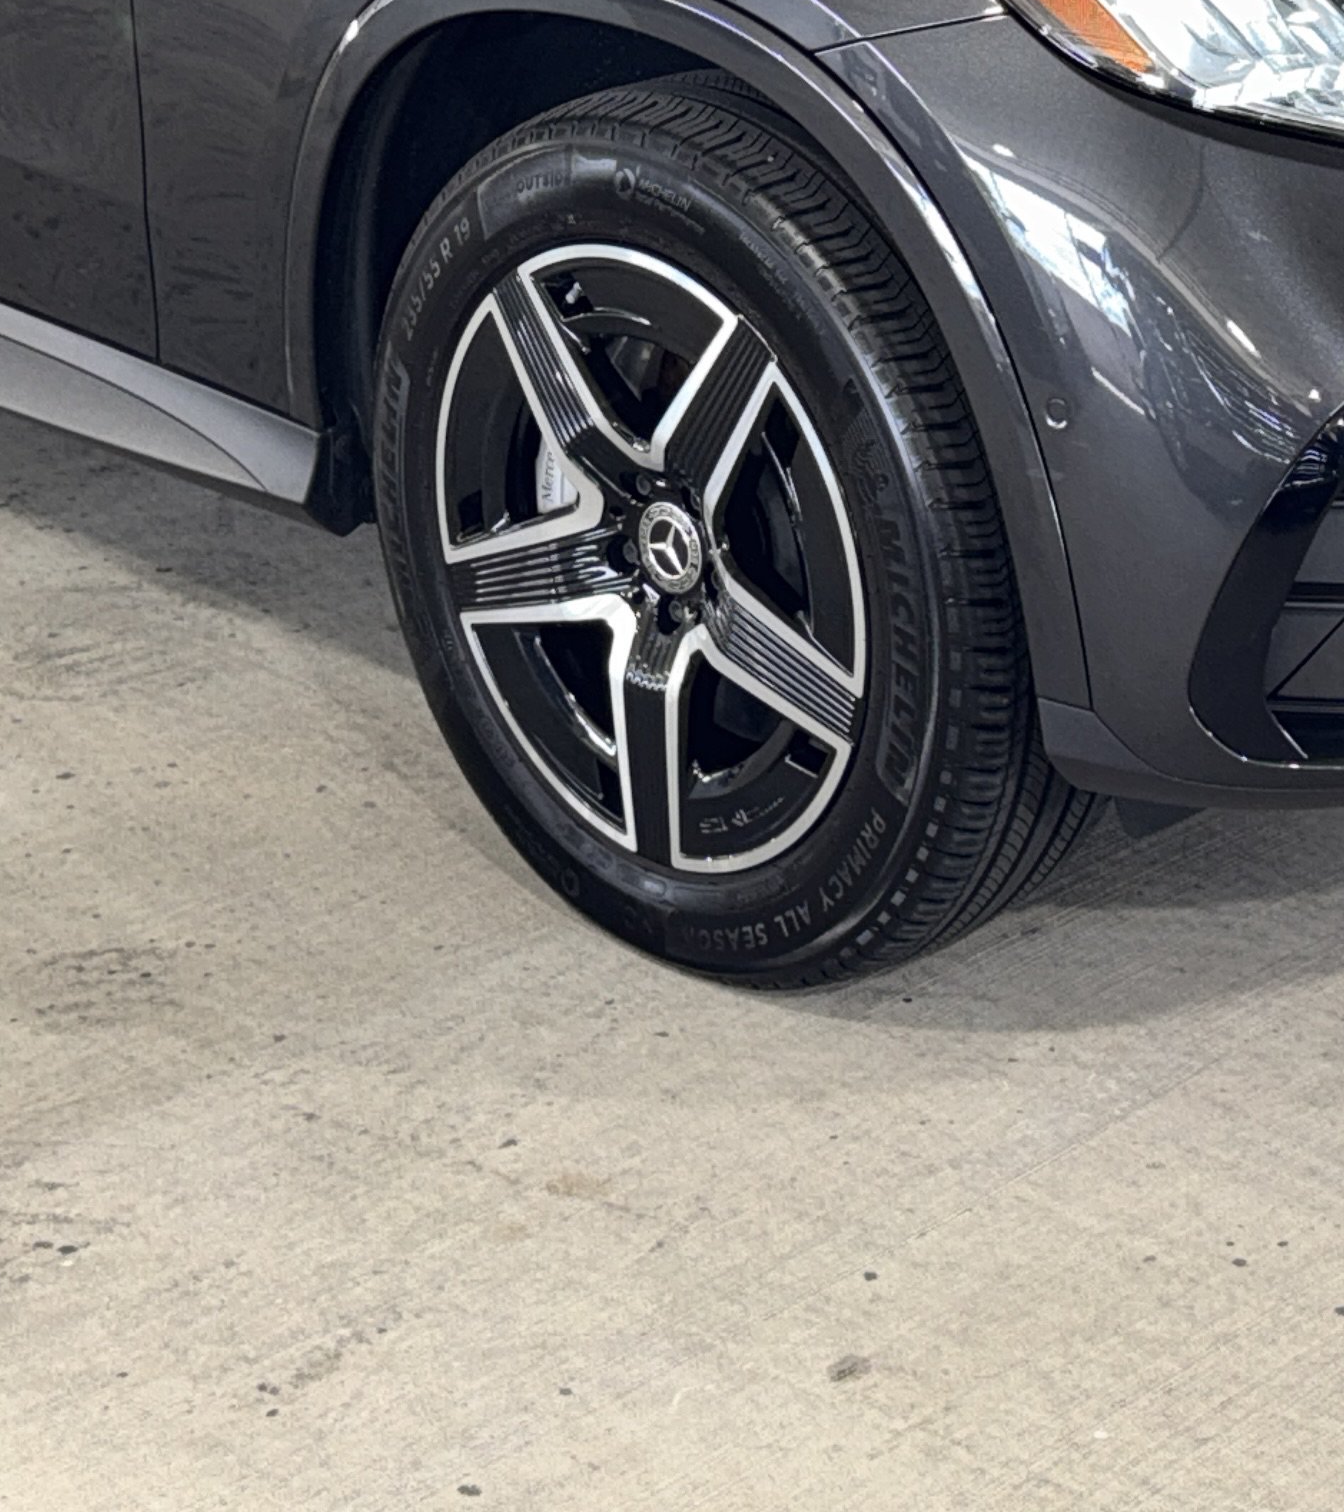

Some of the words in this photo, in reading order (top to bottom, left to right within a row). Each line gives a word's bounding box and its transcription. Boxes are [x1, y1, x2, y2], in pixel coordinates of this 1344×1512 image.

[639, 177, 692, 212] MICHELIN
[440, 237, 453, 264] R
[454, 217, 471, 246] 19
[878, 518, 918, 780] MICHELIN
[820, 807, 884, 912] PRIMACY
[773, 899, 811, 938] ALL
